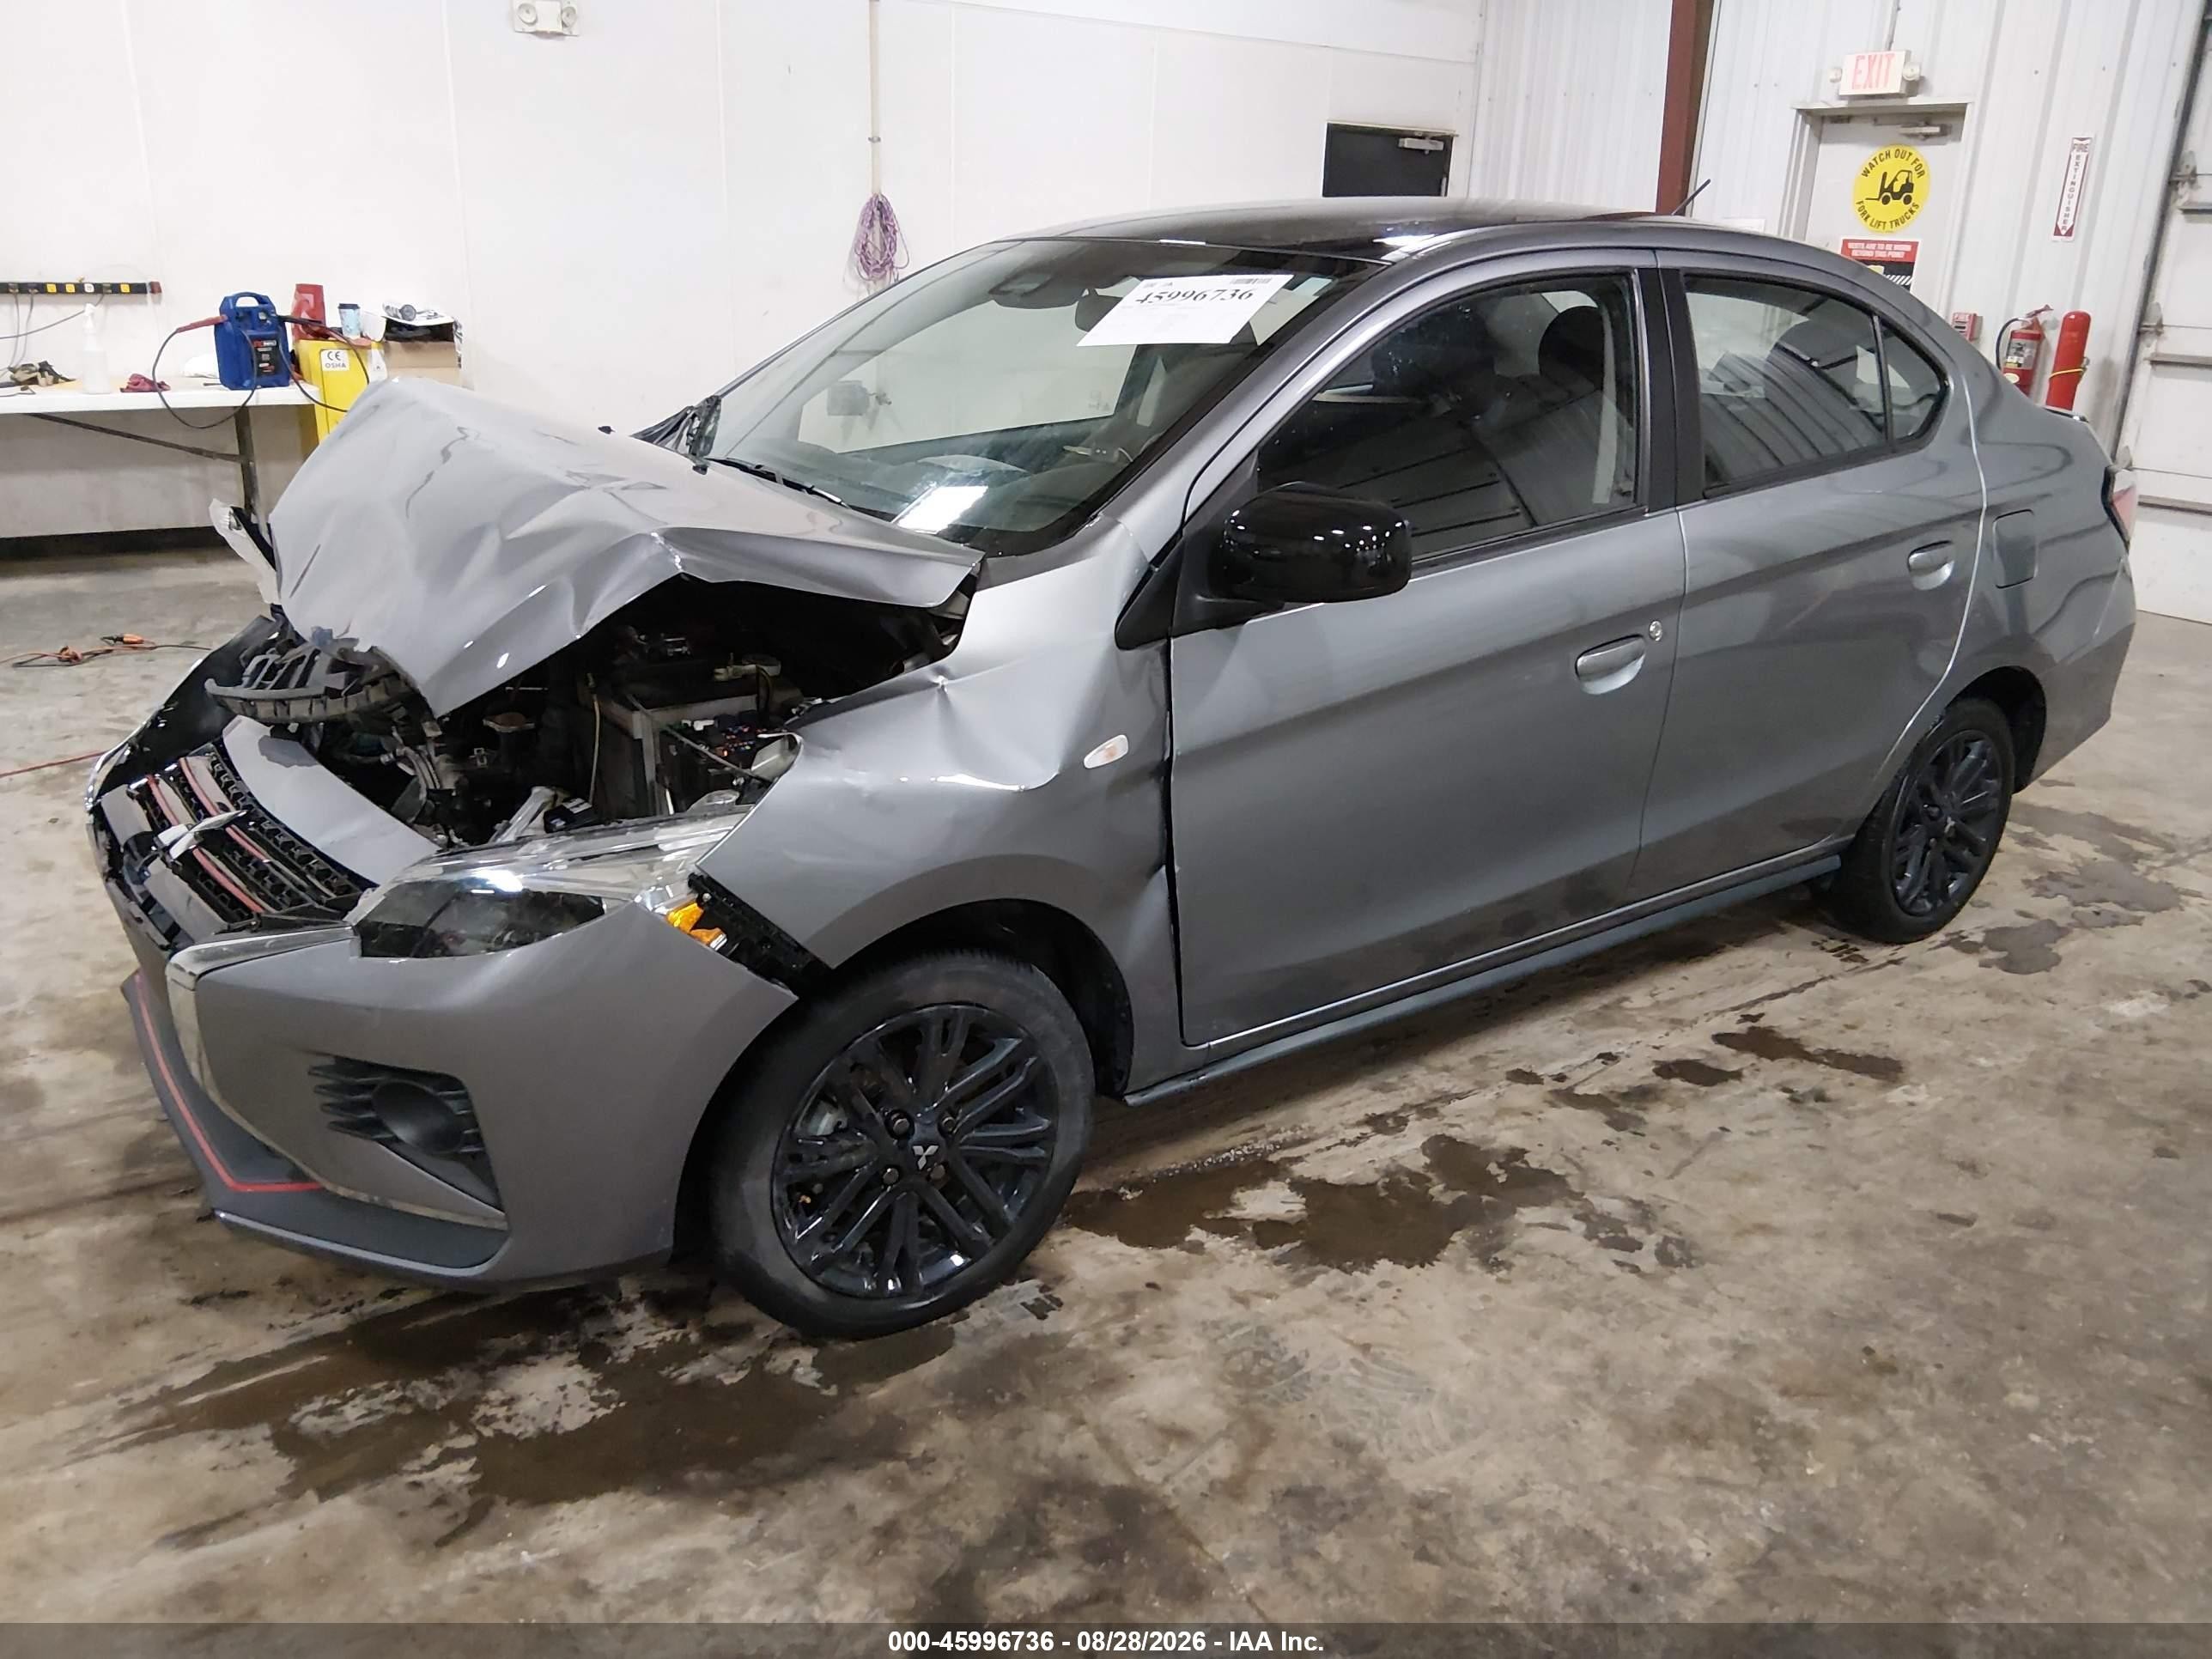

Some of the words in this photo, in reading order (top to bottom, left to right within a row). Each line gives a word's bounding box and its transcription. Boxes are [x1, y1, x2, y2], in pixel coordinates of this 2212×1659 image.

[1851, 53, 1895, 89] EXIT
[1861, 150, 1891, 178] WATCH
[1894, 149, 1913, 161] OUT
[1911, 157, 1925, 179] FOR
[2061, 155, 2081, 231] EXTINGUISHER
[1856, 200, 1871, 222] FORK
[1869, 218, 1887, 230] LIFT
[1889, 202, 1920, 229] TRUCKS
[1135, 289, 1254, 304] 45996736
[327, 351, 341, 361] CE
